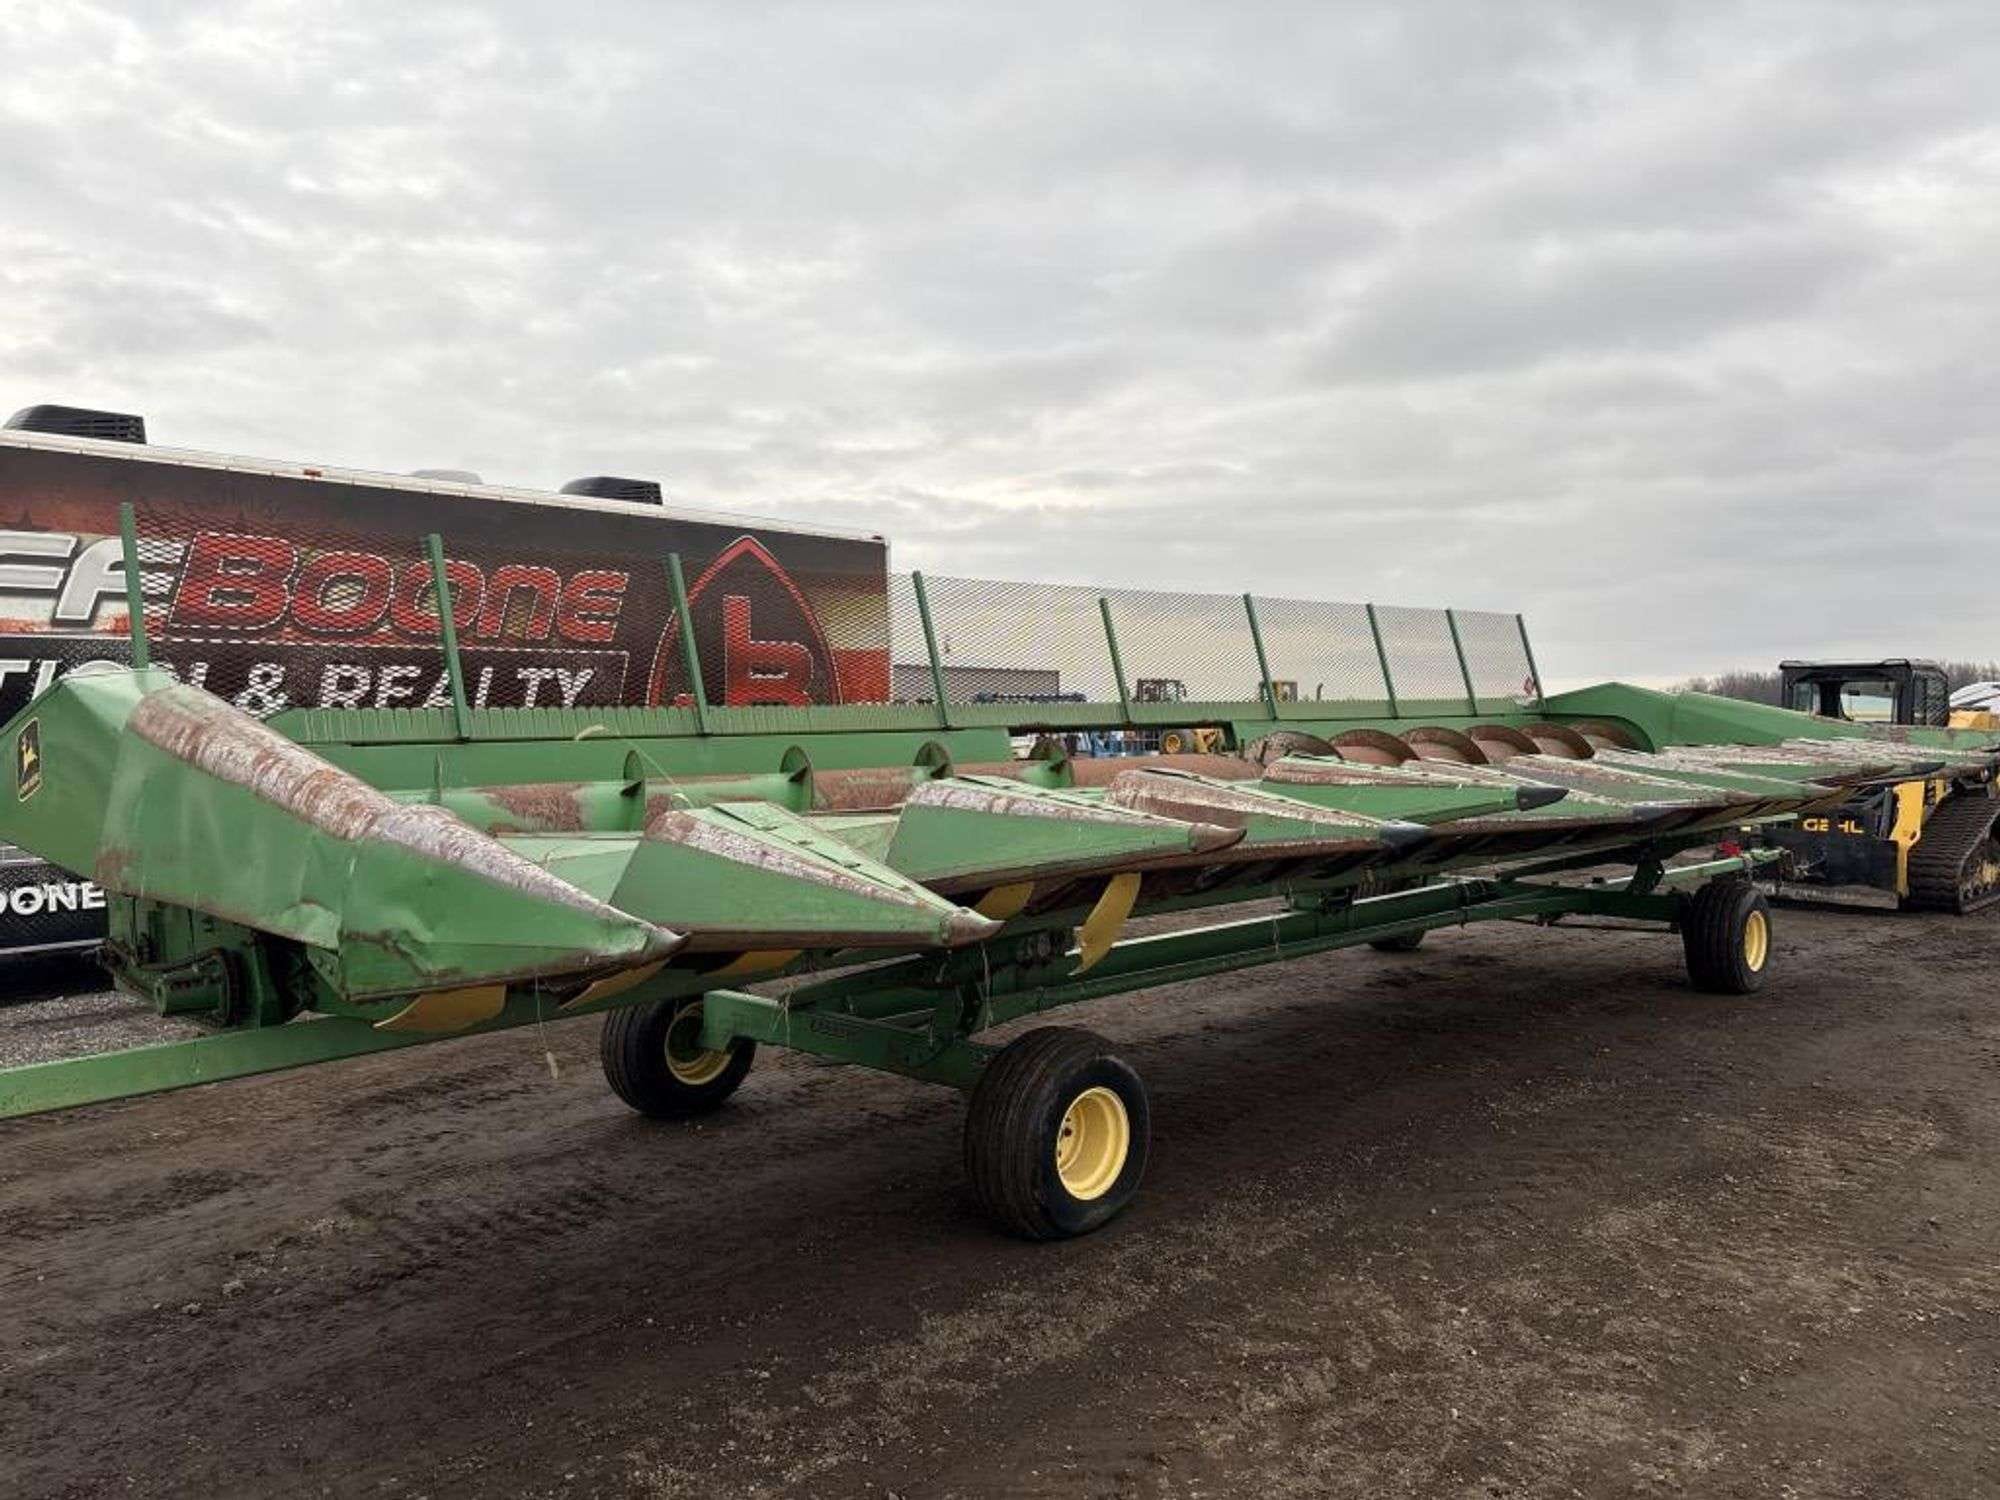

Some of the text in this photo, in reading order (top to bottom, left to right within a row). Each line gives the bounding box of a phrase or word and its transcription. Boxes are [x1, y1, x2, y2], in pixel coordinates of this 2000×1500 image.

[235, 664, 288, 719] &
[1803, 819, 1864, 834] GEHL
[0, 882, 106, 915] ONE
